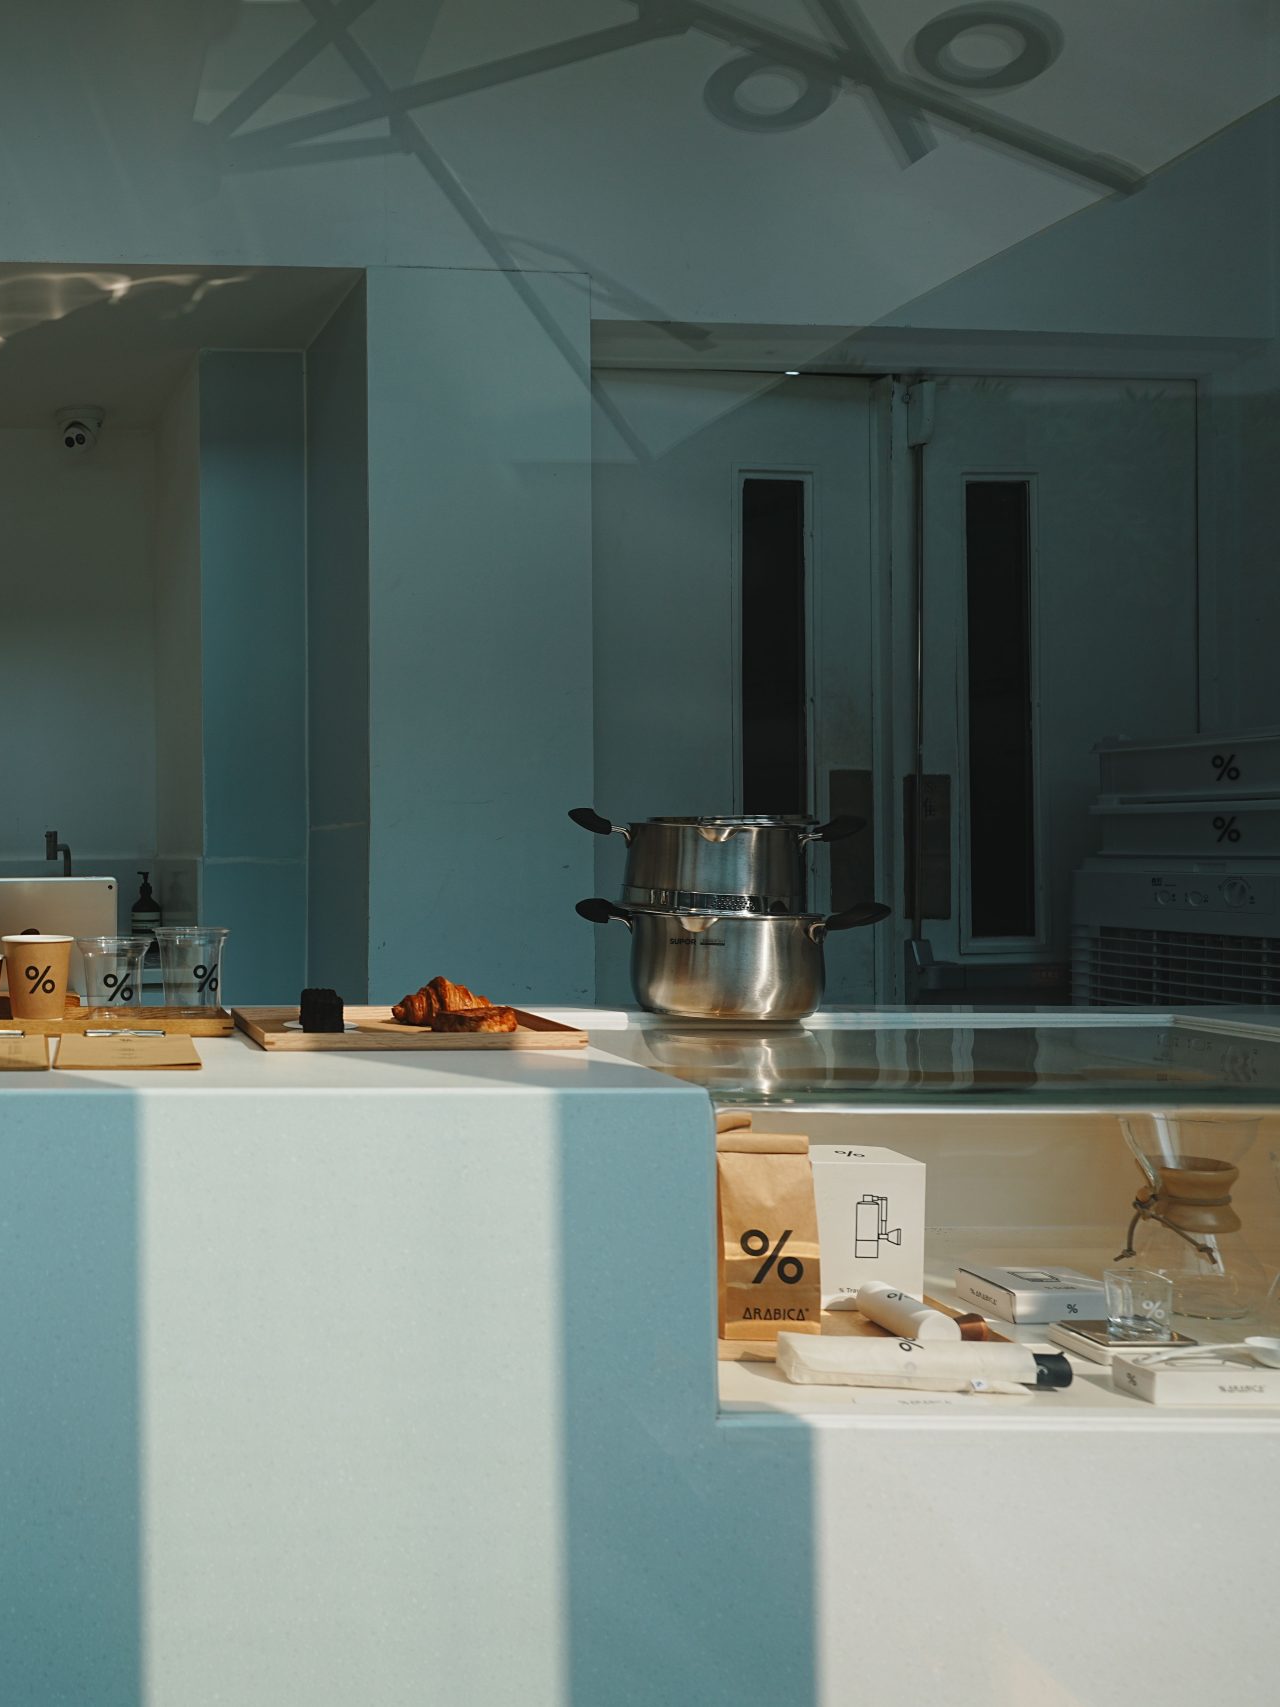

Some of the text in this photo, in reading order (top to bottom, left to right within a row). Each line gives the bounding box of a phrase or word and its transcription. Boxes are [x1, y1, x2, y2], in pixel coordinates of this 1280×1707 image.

[1211, 754, 1240, 782] %
[1212, 816, 1241, 843] %
[24, 965, 56, 995] %
[103, 972, 134, 1002] %
[192, 963, 219, 993] %
[740, 1228, 805, 1285] %
